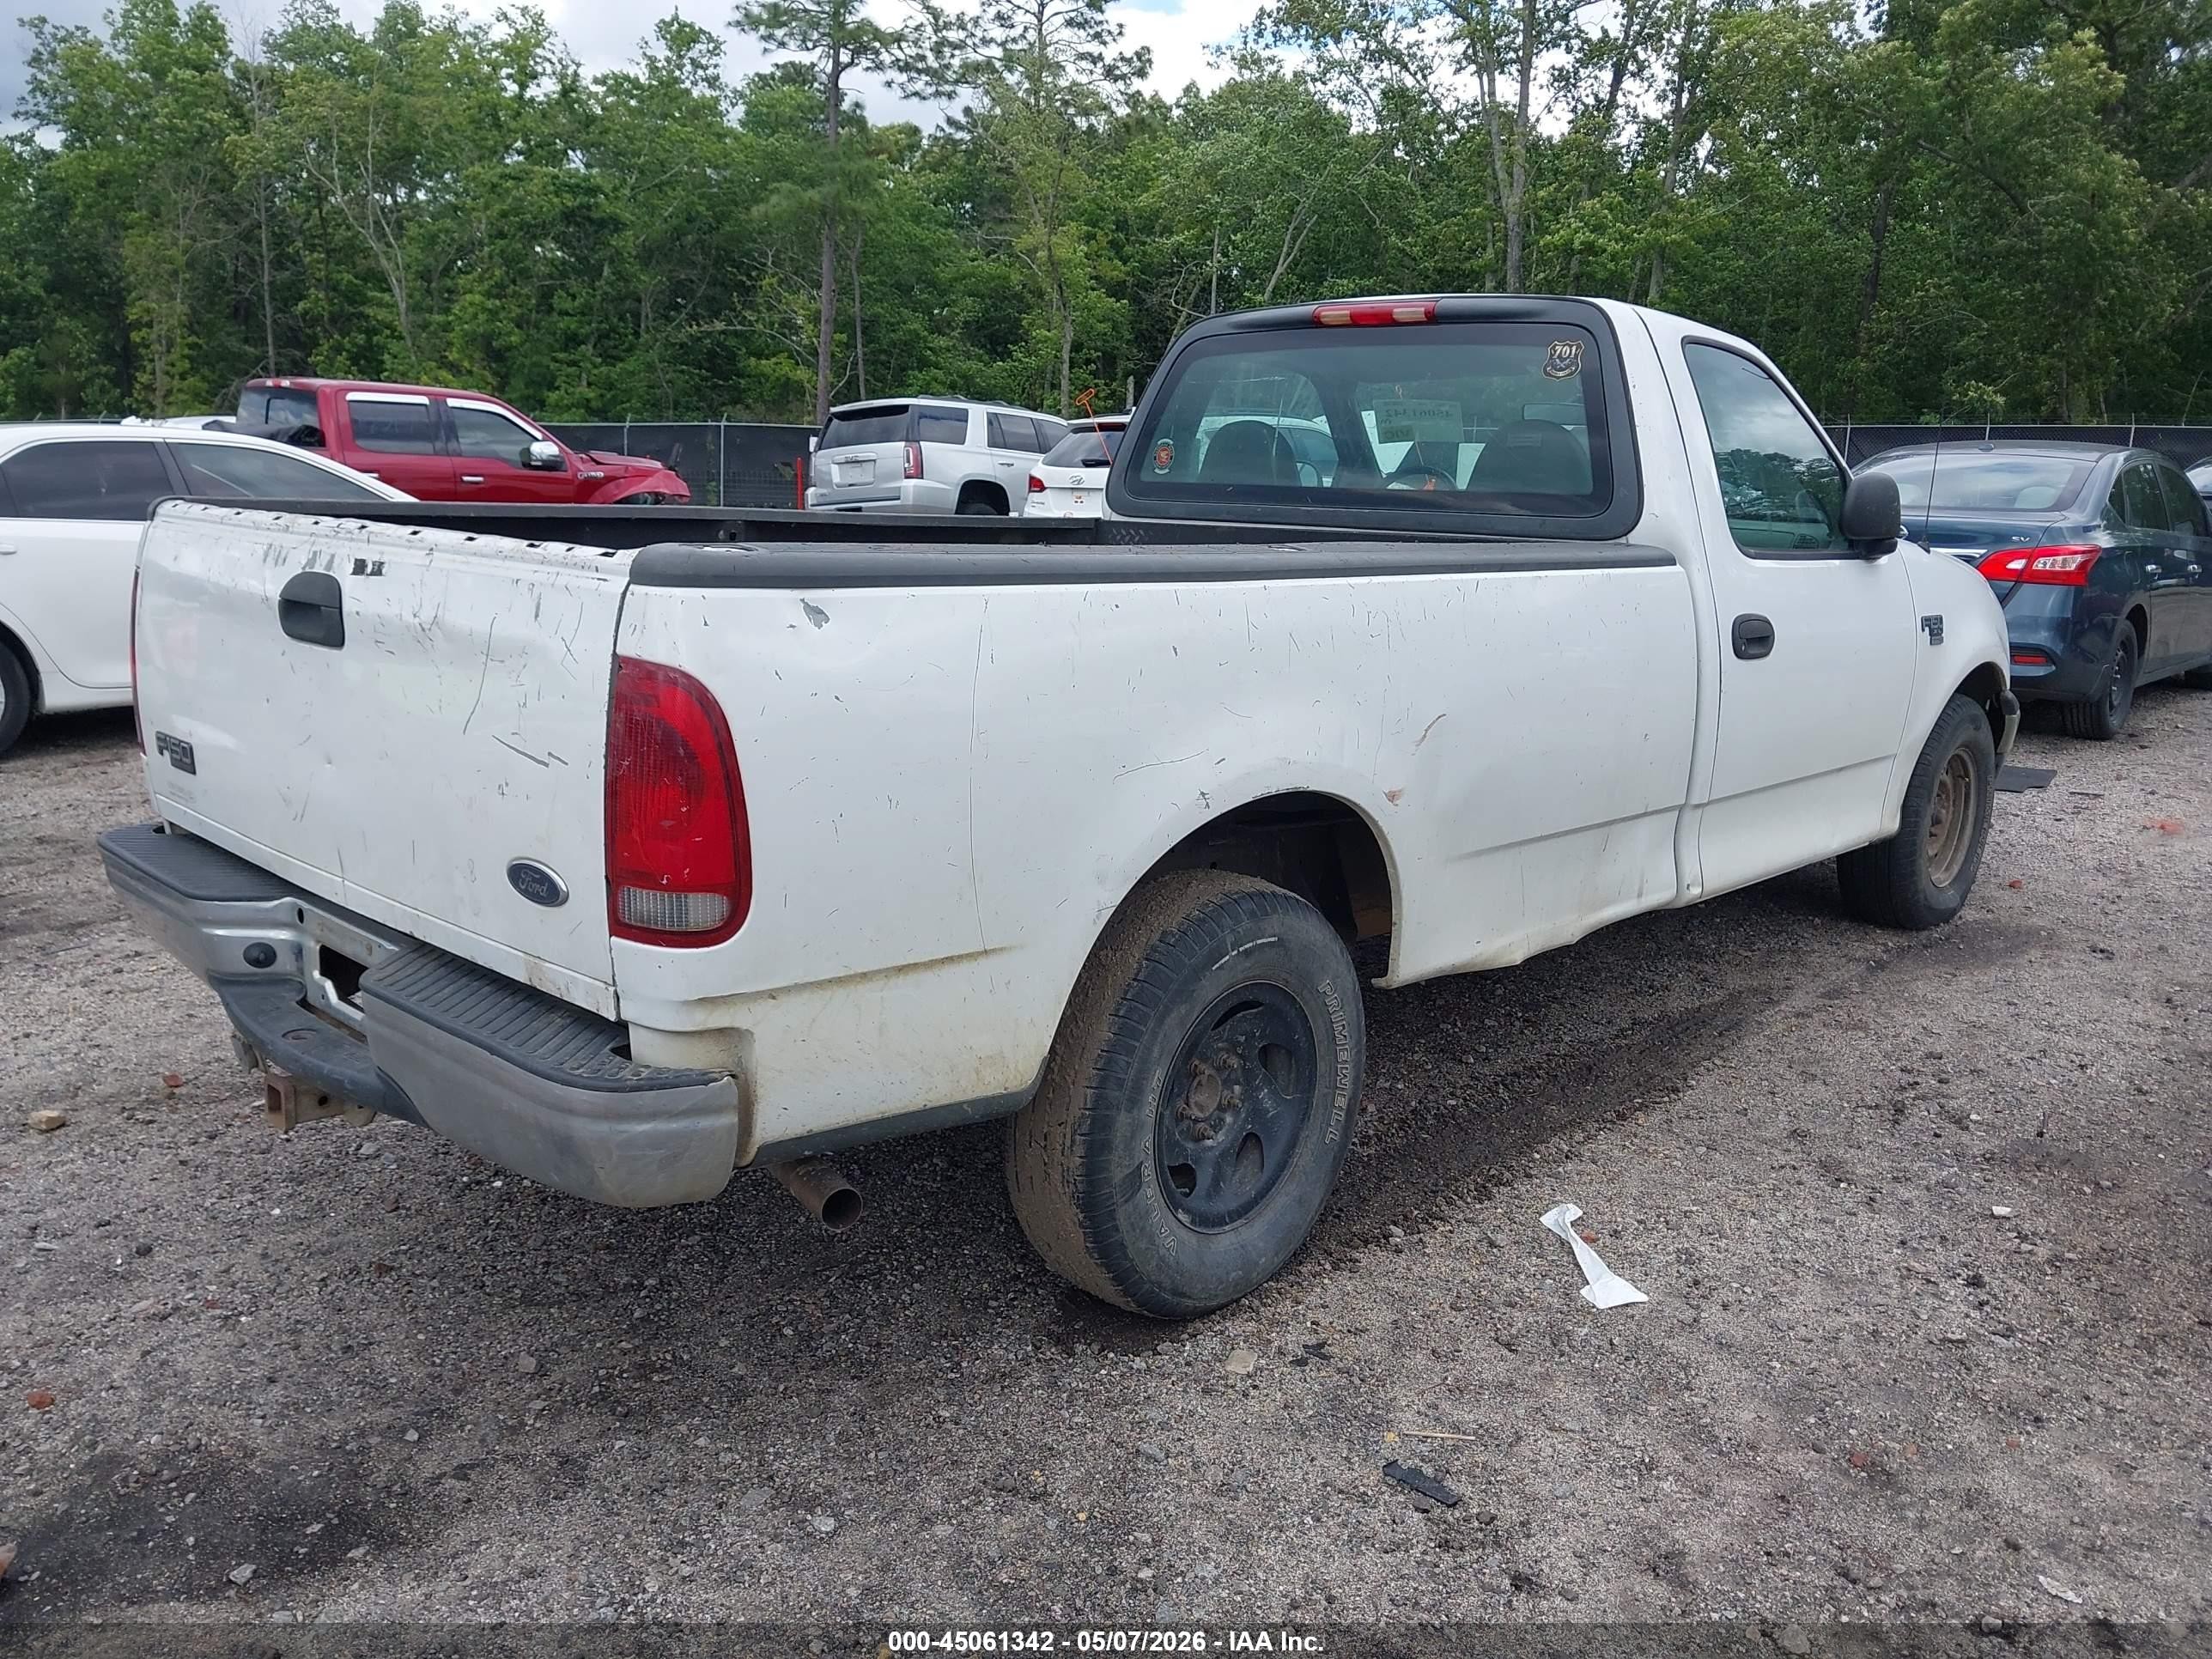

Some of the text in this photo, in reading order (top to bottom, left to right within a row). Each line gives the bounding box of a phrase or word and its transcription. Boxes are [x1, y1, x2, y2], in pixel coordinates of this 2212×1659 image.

[1552, 344, 1577, 359] 701
[517, 867, 550, 898] Ford
[1317, 979, 1351, 1145] PRIMEWELL
[1140, 1133, 1177, 1257] VALERA
